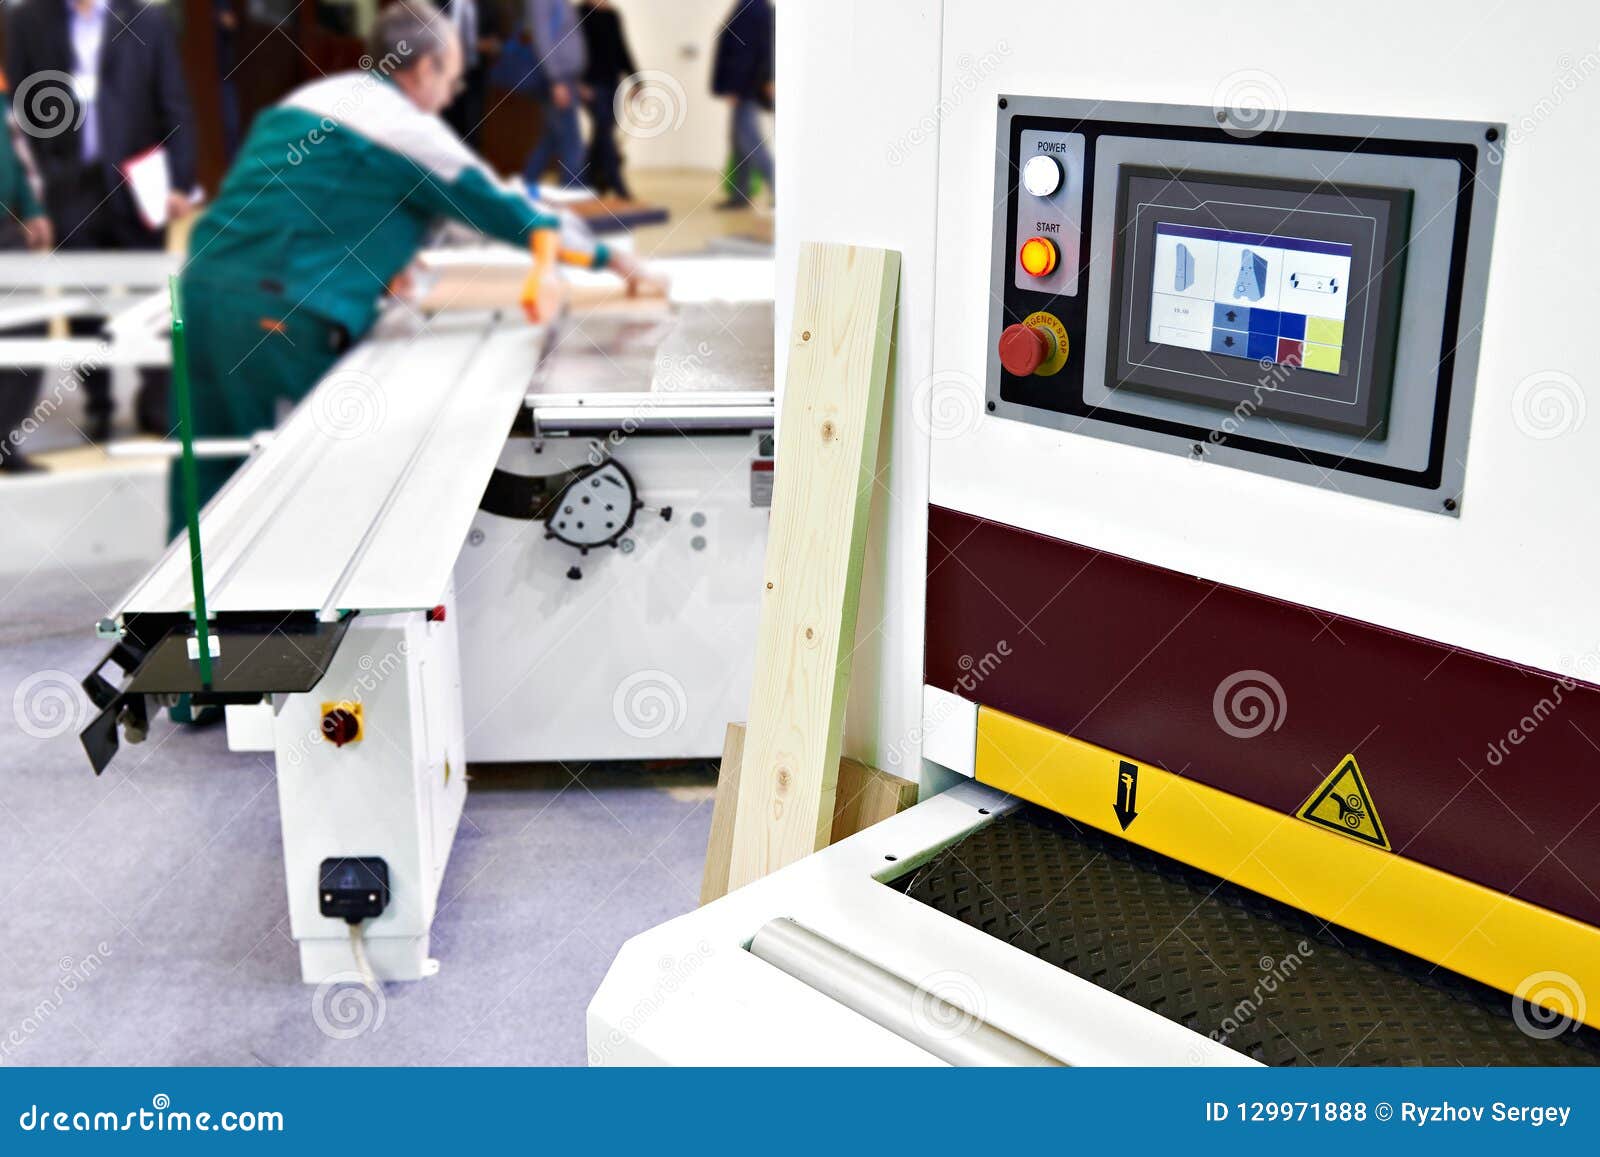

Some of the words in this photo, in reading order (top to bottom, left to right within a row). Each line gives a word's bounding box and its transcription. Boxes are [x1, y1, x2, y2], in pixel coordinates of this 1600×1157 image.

[1038, 141, 1066, 153] POWER
[1036, 222, 1060, 233] START
[1026, 315, 1057, 328] RGENCY
[1057, 327, 1067, 354] STOP
